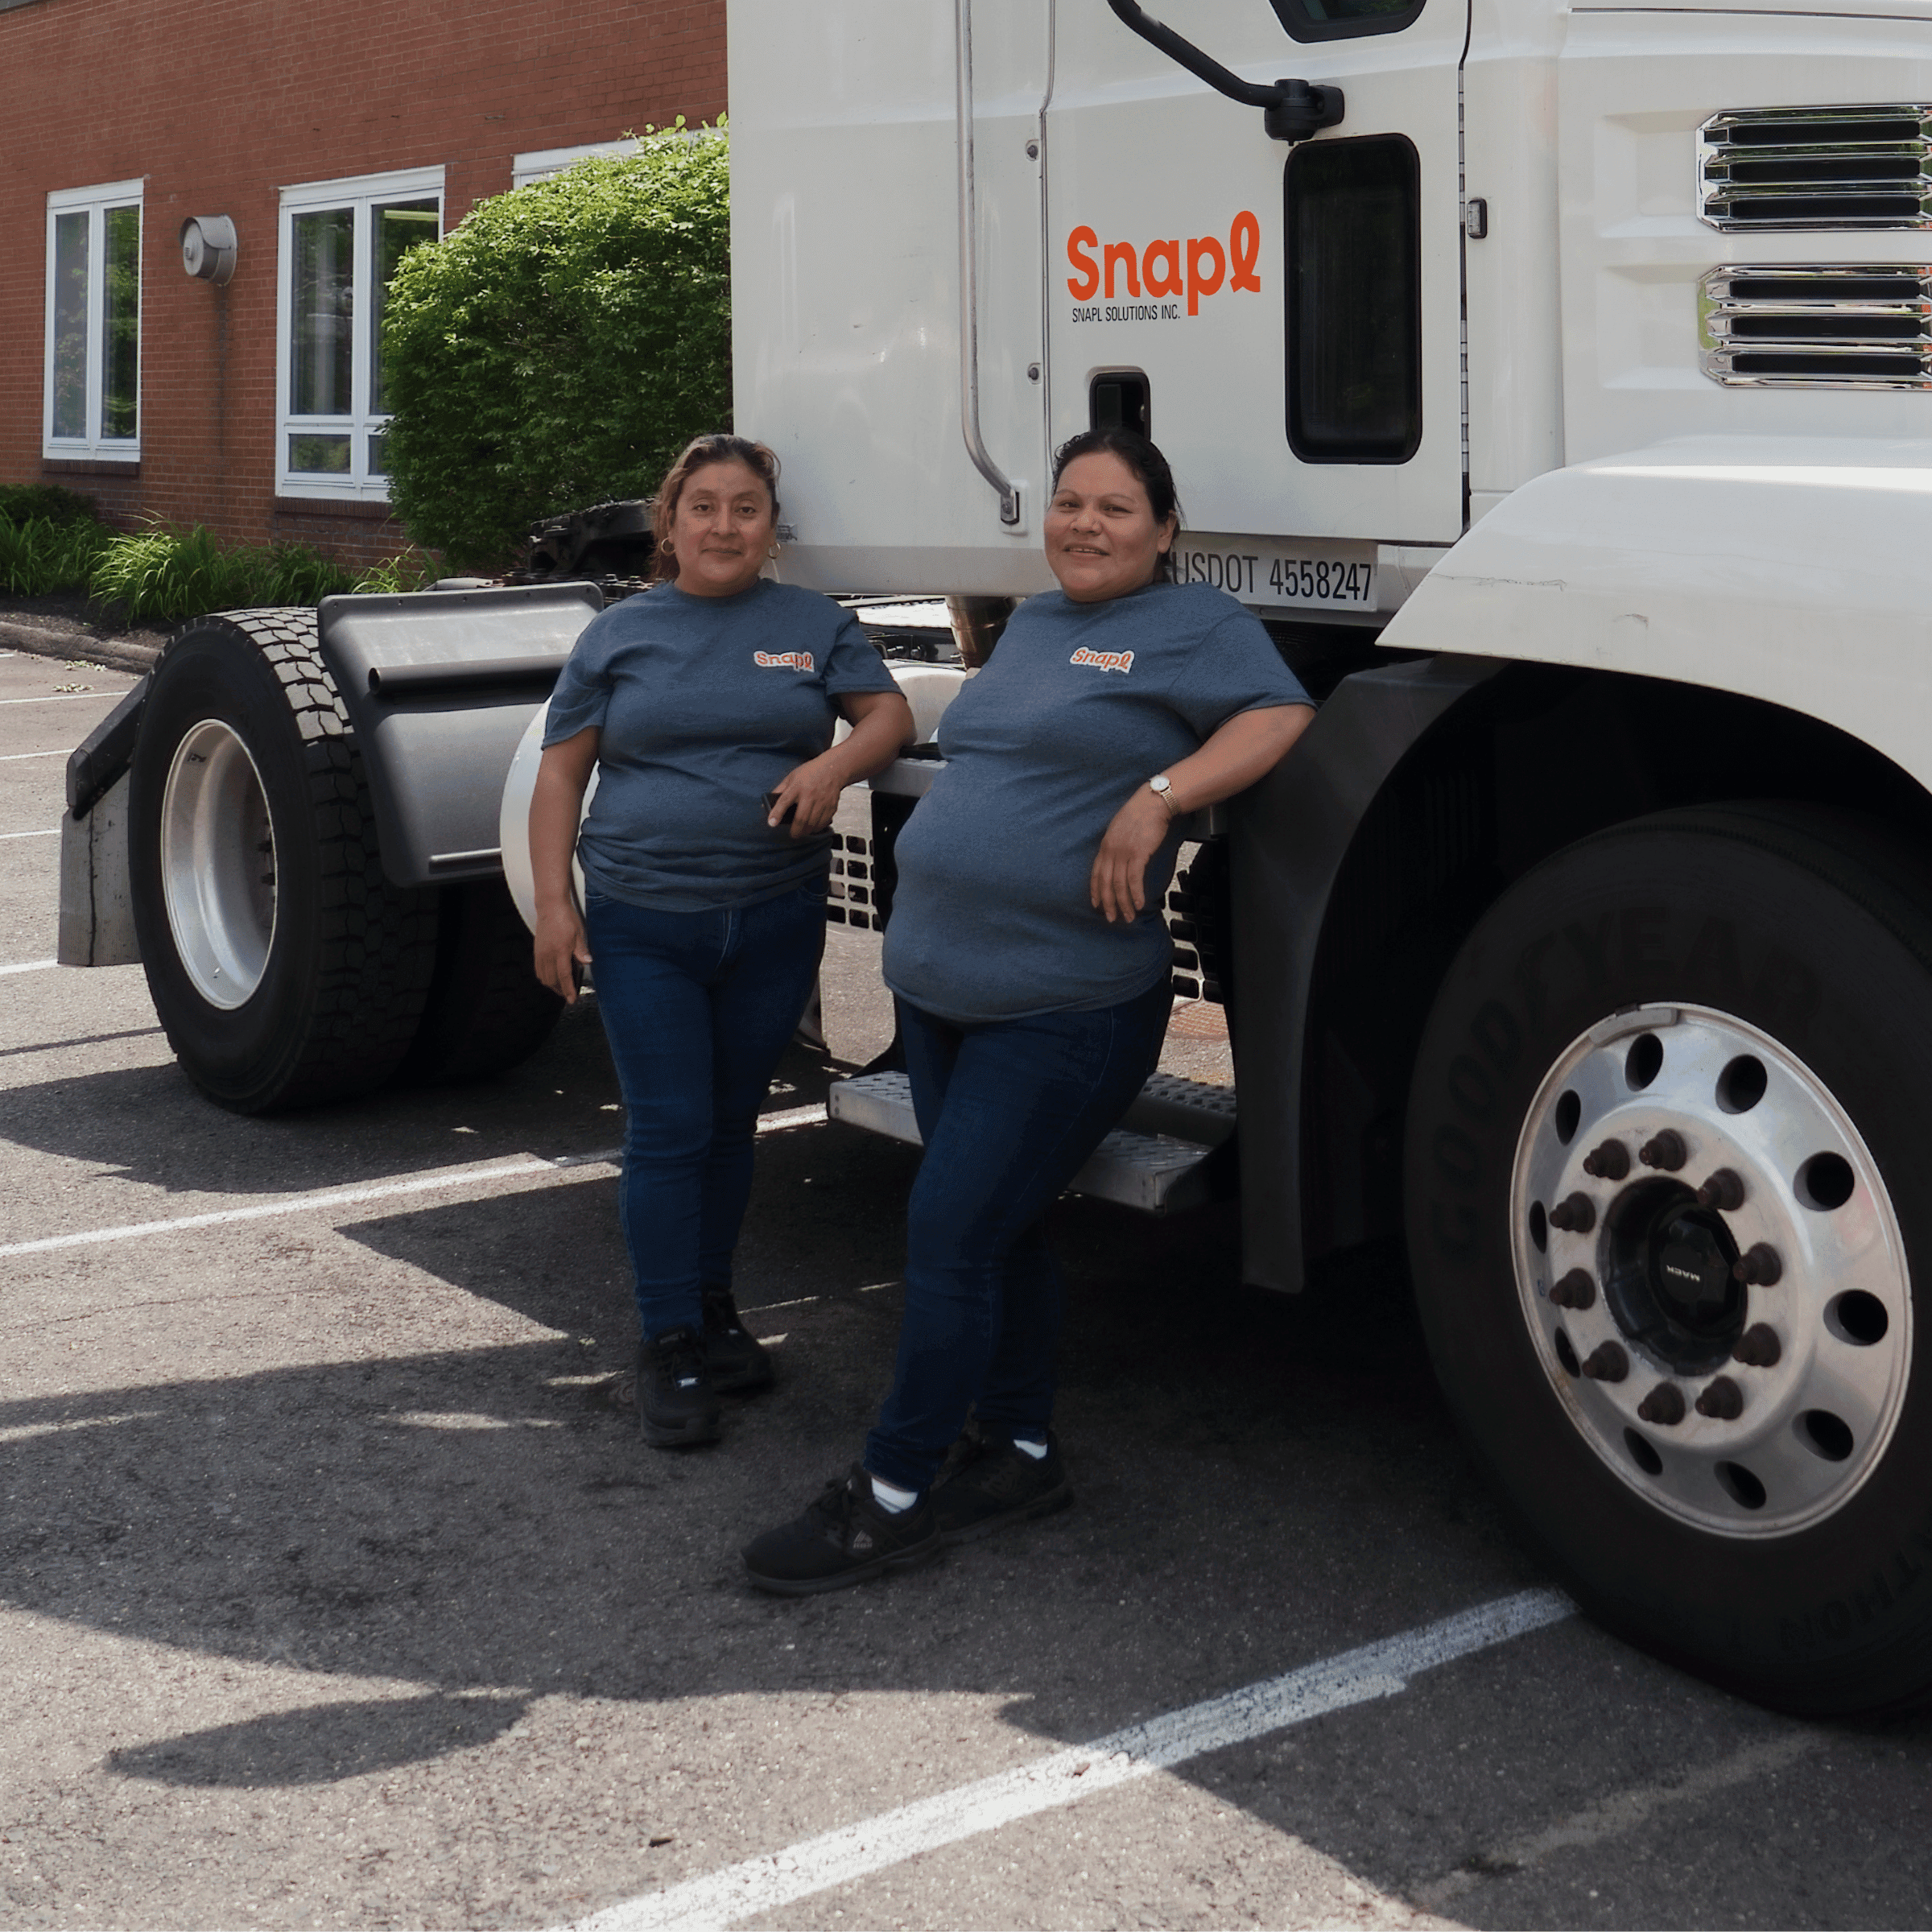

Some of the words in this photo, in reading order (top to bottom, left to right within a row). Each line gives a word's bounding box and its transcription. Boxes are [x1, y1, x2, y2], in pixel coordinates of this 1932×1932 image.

[1067, 210, 1261, 316] Snapl
[1072, 308, 1102, 323] SNAPL
[1105, 305, 1158, 321] SOLUTIONS
[1162, 304, 1181, 320] INC.
[1172, 552, 1258, 593] USDOT
[1269, 559, 1372, 601] 4558247
[1072, 649, 1131, 669] Snapl
[1429, 902, 1823, 1264] GOODYEAR
